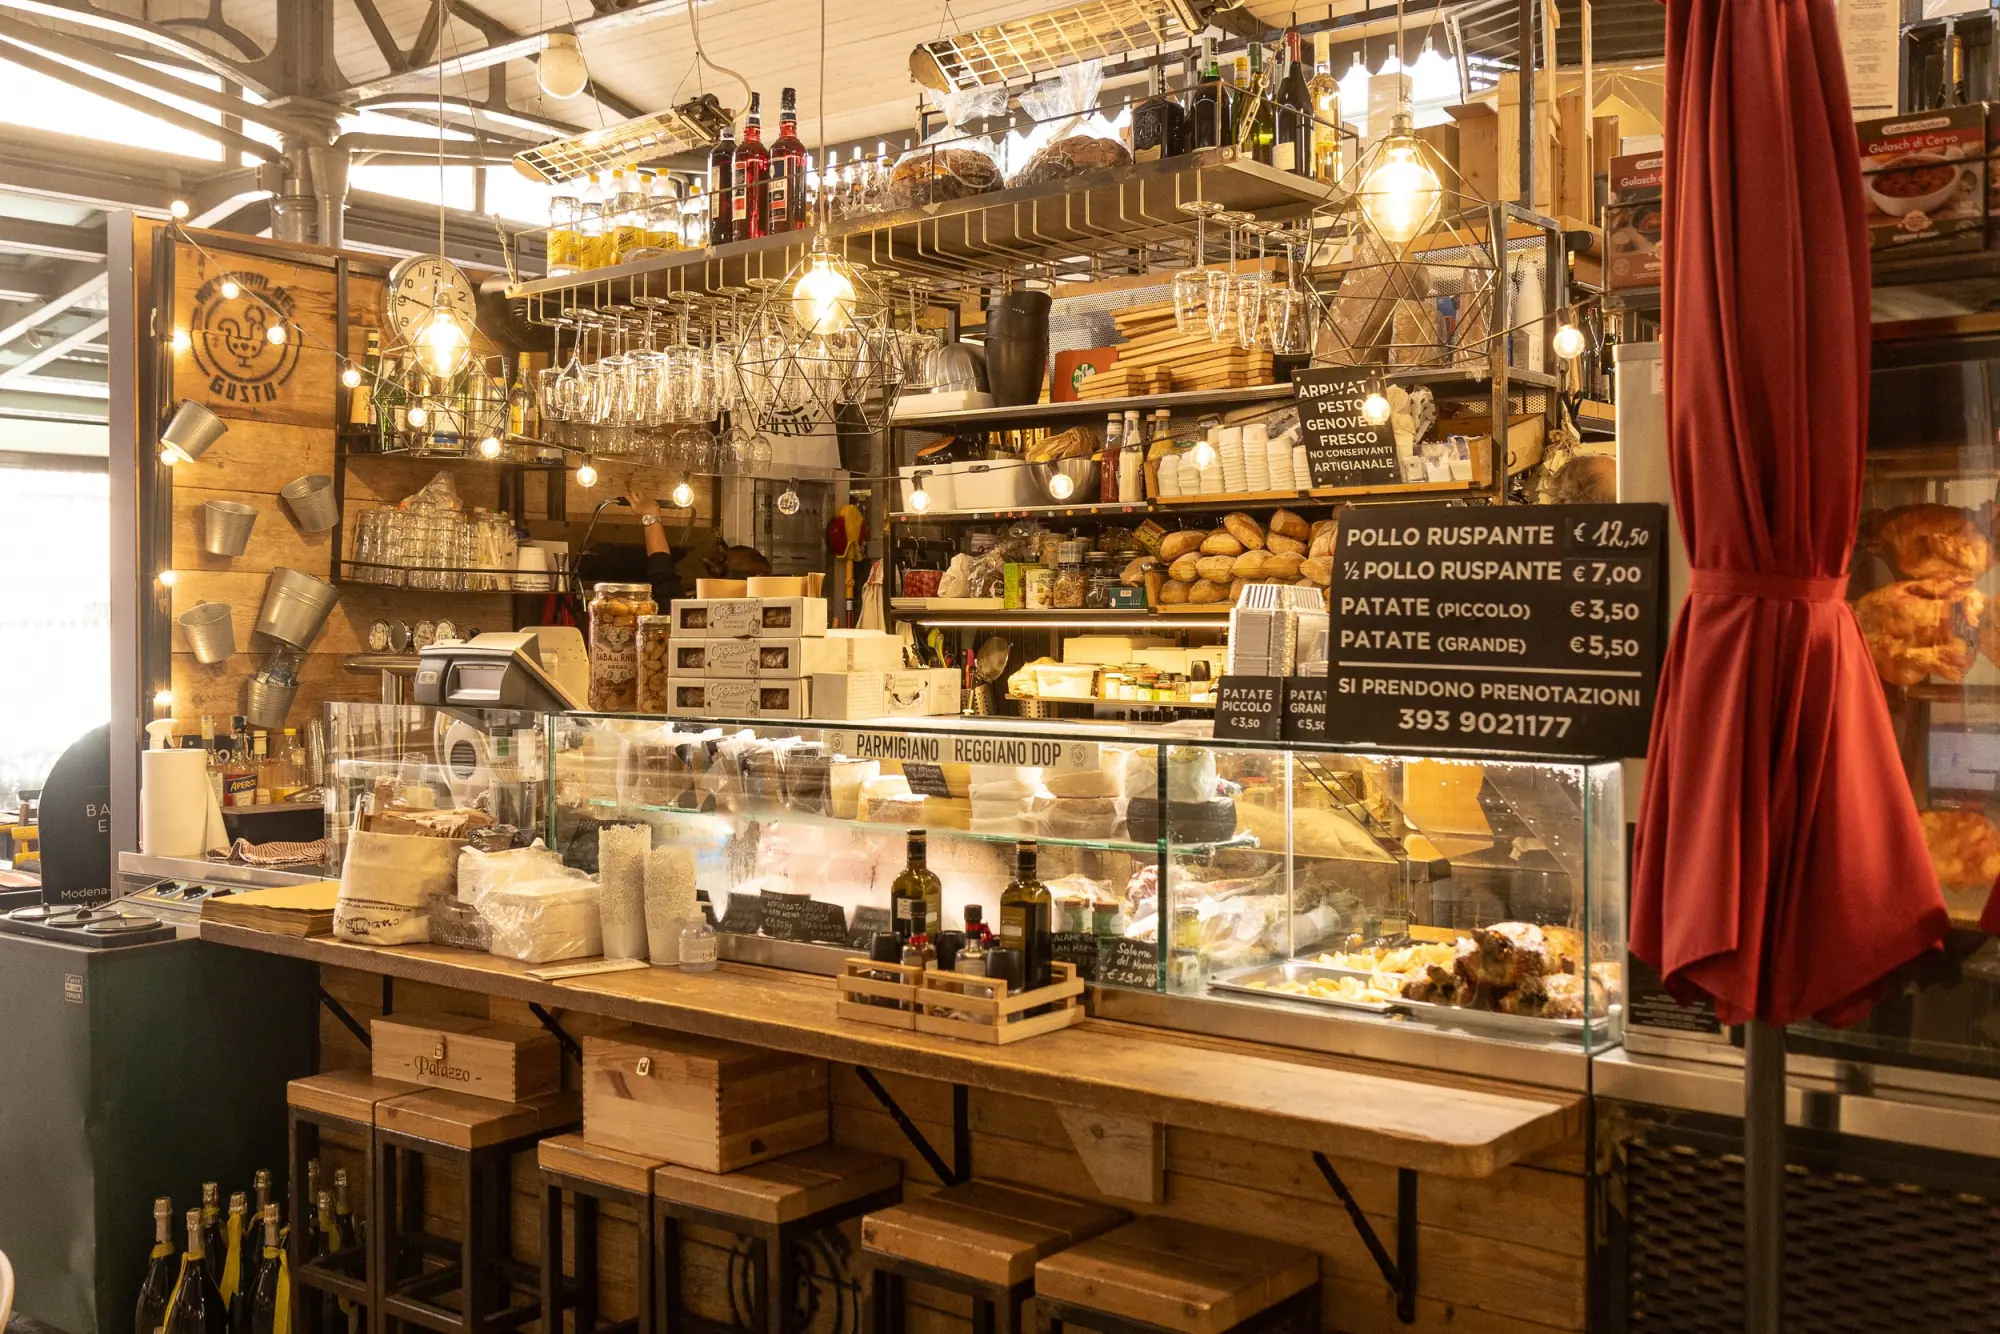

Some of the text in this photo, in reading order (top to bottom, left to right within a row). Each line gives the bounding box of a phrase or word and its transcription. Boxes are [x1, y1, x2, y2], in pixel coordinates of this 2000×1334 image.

[1868, 134, 1958, 154] Gulasch di Cervo
[1620, 174, 1656, 187] Gulasch
[418, 267, 426, 278] 11
[432, 265, 442, 277] 12
[405, 278, 414, 289] 10
[1298, 380, 1381, 399] ARRIVAT
[1317, 398, 1366, 414] PESTO
[1306, 415, 1369, 431] GENOVE
[1319, 431, 1378, 447] FRESCO
[1309, 446, 1393, 459] NO CONSERVANTI
[1314, 458, 1395, 473] ARTIGIANALE
[1346, 527, 1420, 547] POLLO
[1426, 525, 1555, 546] RUSPANTE
[1363, 560, 1435, 580] POLLO
[1440, 560, 1562, 581] RUSPANTE
[1340, 597, 1431, 617] PATATE
[1436, 602, 1531, 620] (PICCOLO)
[1340, 630, 1431, 650] PATATE
[1437, 635, 1527, 655] (GRANDE)
[1223, 688, 1273, 700] PATATE
[1338, 677, 1641, 707] SI PRENDONO PRENOTAZIONI
[1221, 701, 1272, 713] PICCOLO
[1398, 708, 1572, 739] 393 9021177
[856, 733, 940, 762] PARMIGIANO
[954, 738, 1027, 765] REGGIANO
[1031, 742, 1062, 767] DOP
[1116, 942, 1153, 959] Salame
[414, 1055, 470, 1082] Palazzo
